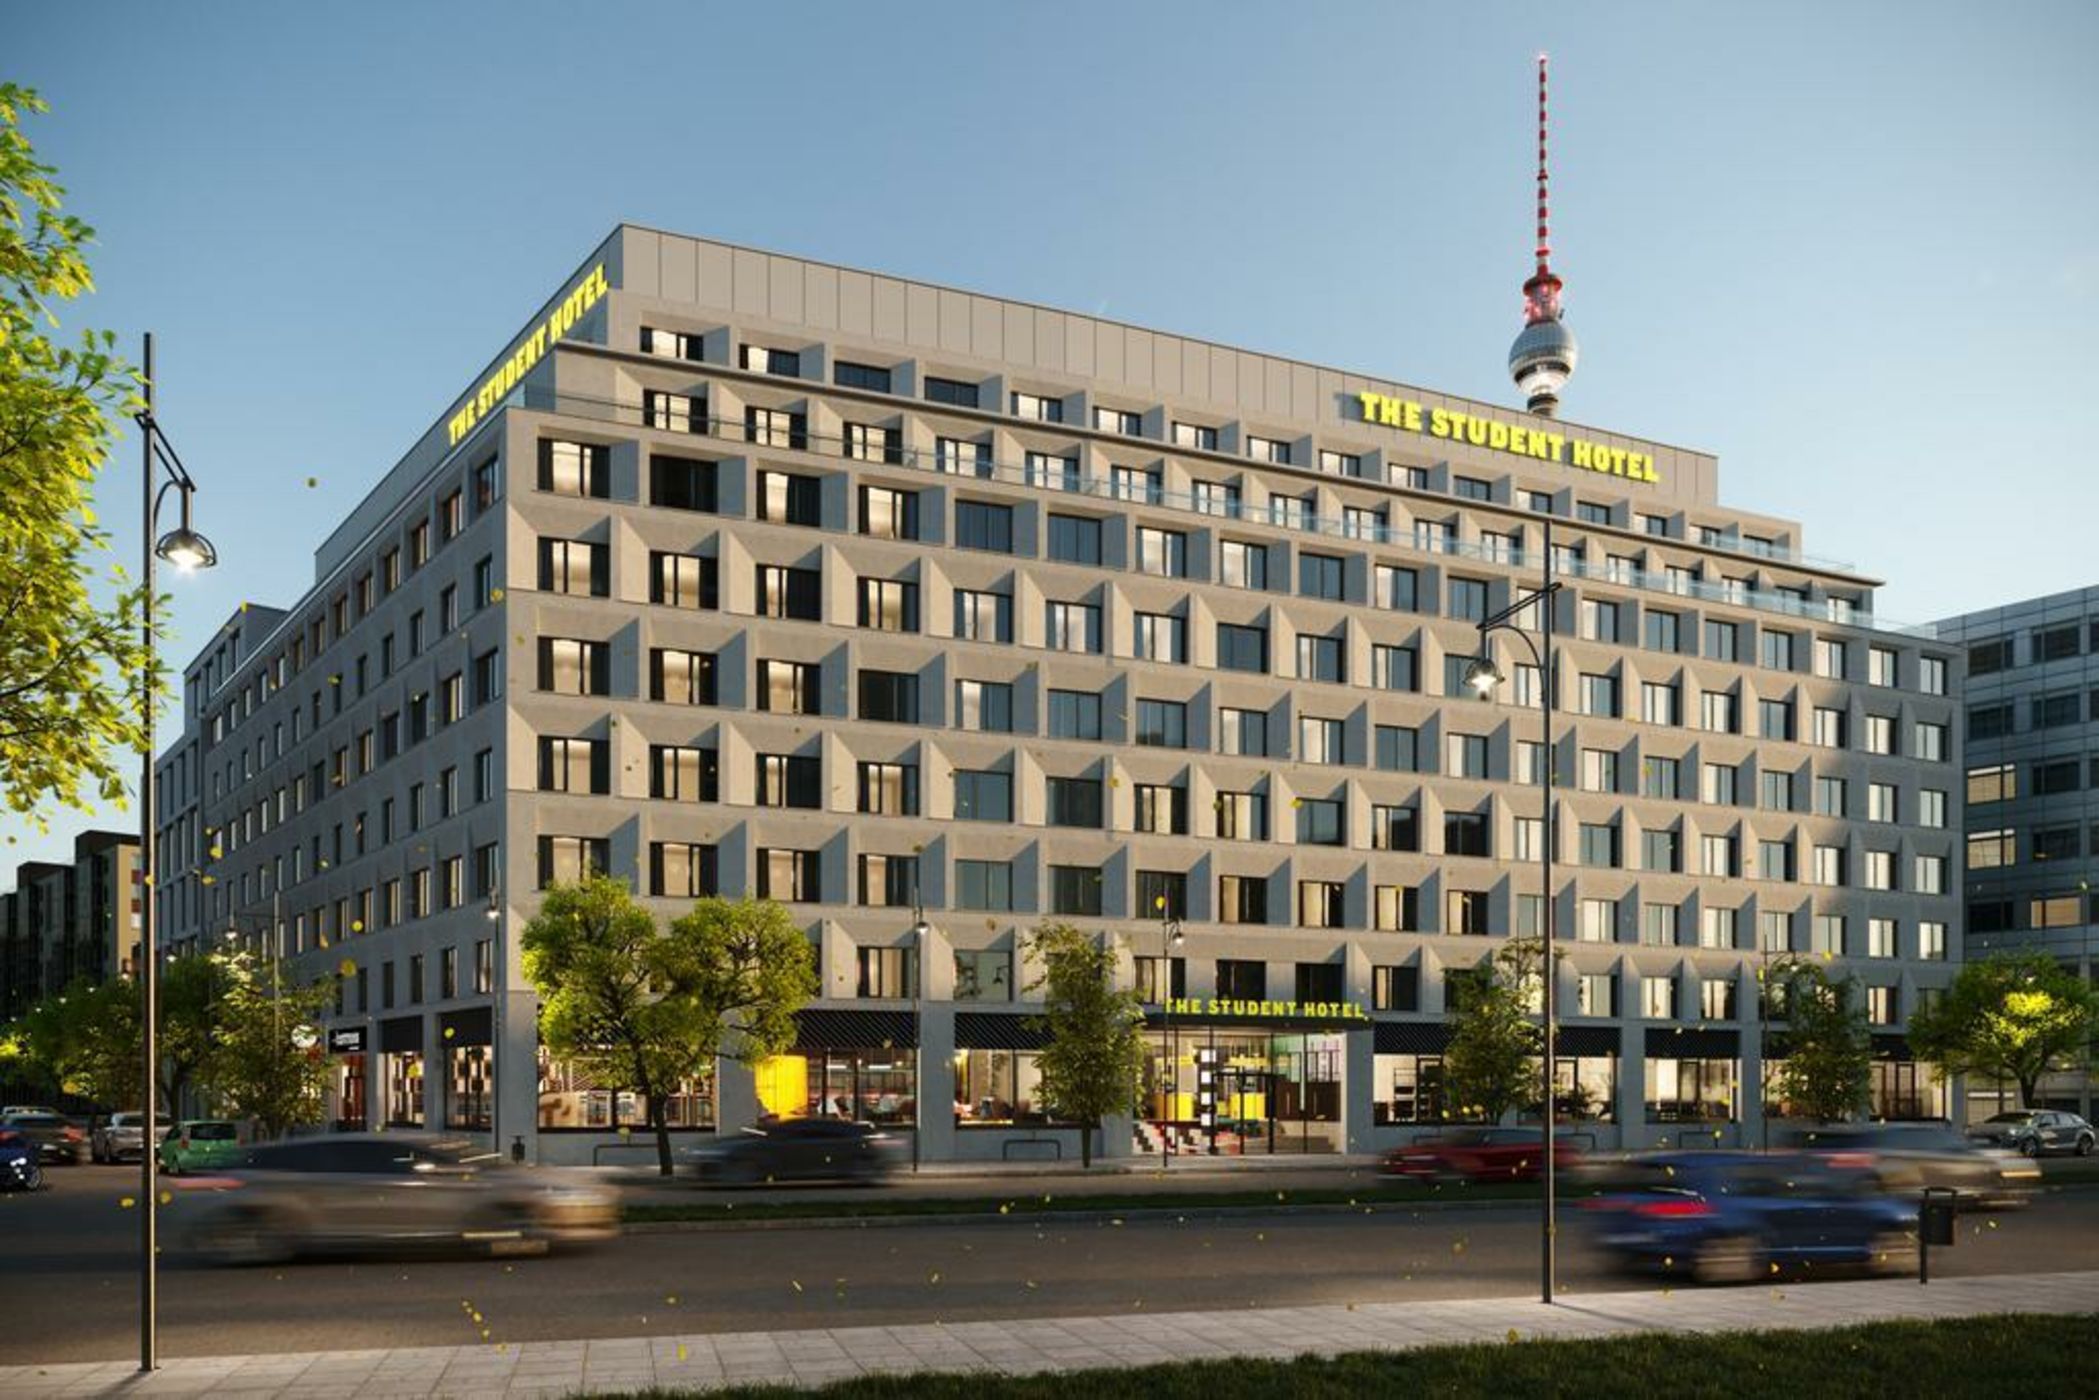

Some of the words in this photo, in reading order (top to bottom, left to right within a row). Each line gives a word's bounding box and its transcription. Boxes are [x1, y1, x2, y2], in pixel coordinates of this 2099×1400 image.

[449, 398, 477, 446] THE
[478, 323, 547, 419] STUDENT
[550, 262, 608, 344] HOTEL
[1360, 392, 1422, 431] THE
[1431, 406, 1565, 462] STUDENT
[1573, 438, 1660, 483] HOTEL
[1165, 998, 1202, 1014] THE
[1208, 999, 1297, 1017] STUDENT
[1303, 1001, 1365, 1018] HOTEL
